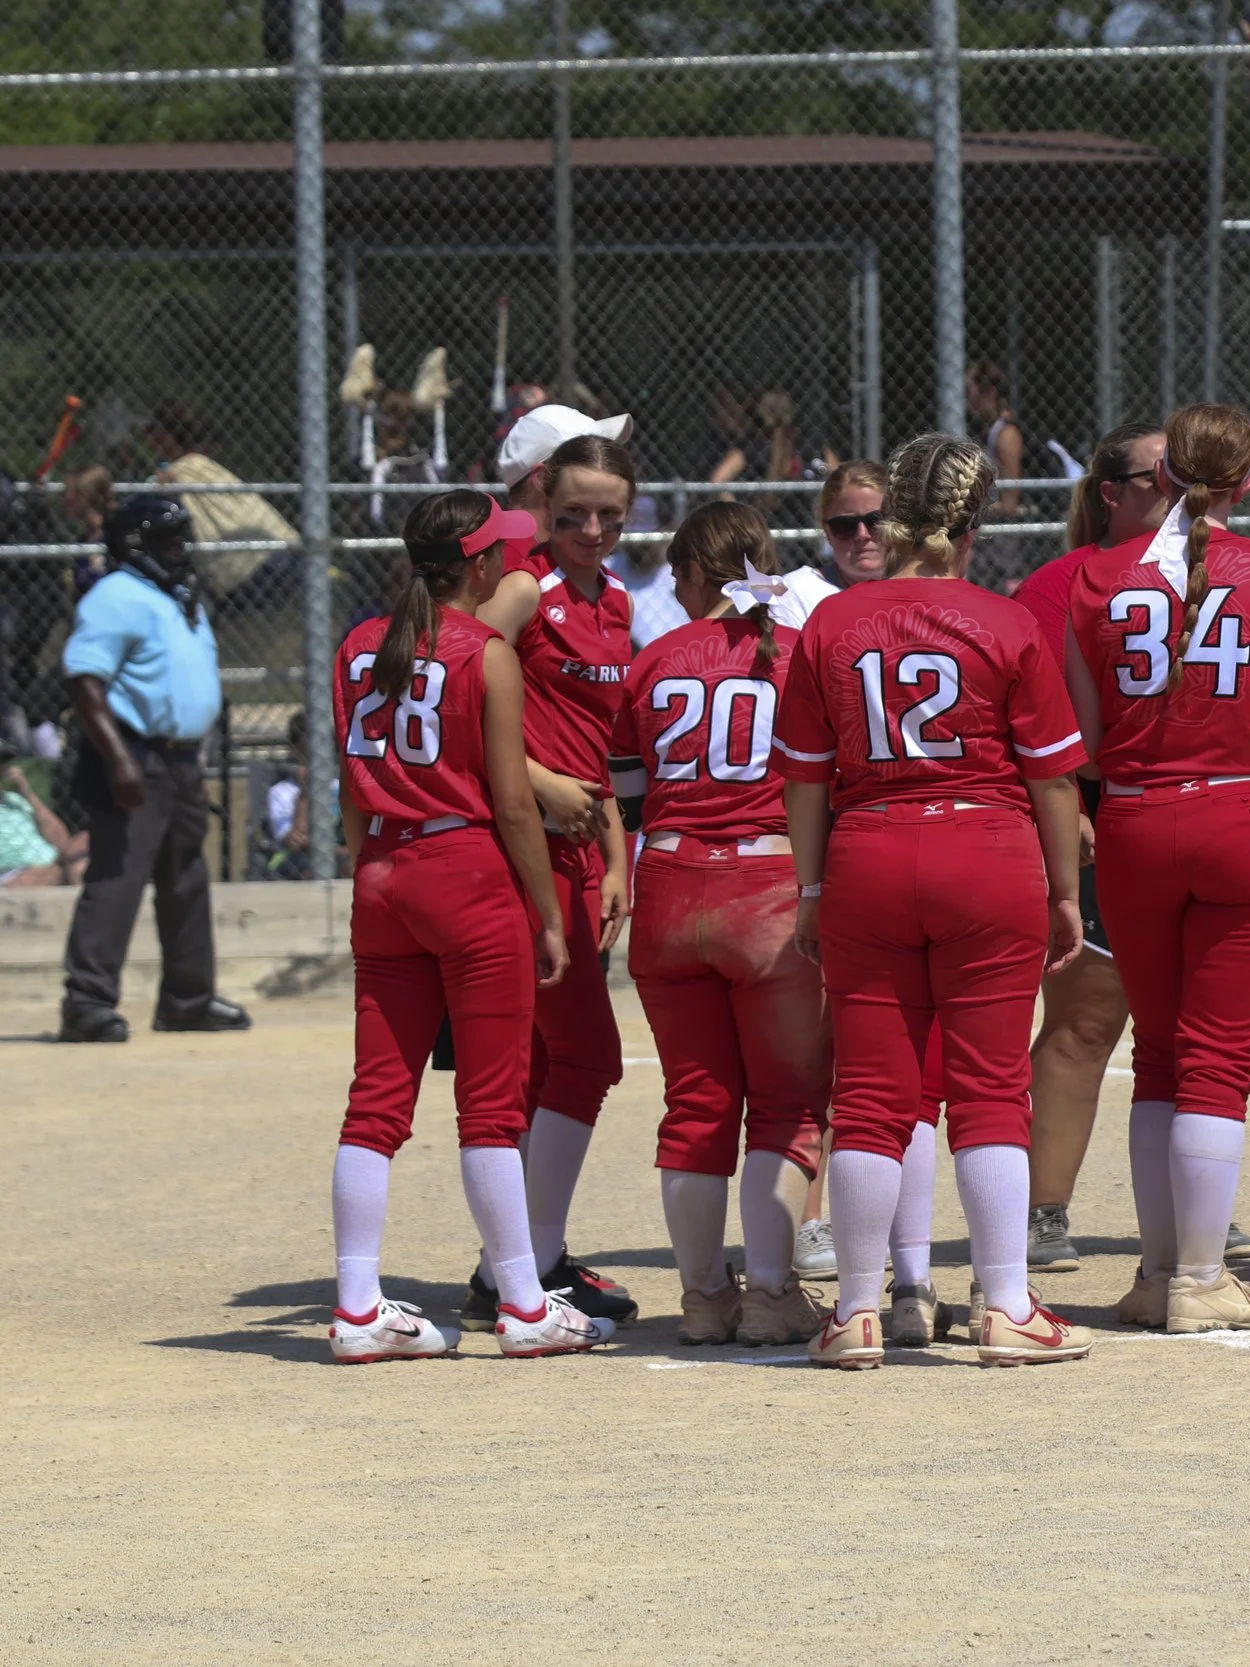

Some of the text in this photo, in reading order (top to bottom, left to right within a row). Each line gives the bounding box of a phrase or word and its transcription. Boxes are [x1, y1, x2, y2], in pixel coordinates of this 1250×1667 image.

[345, 651, 448, 767] 28
[651, 677, 777, 782] 20
[851, 649, 966, 763] 12
